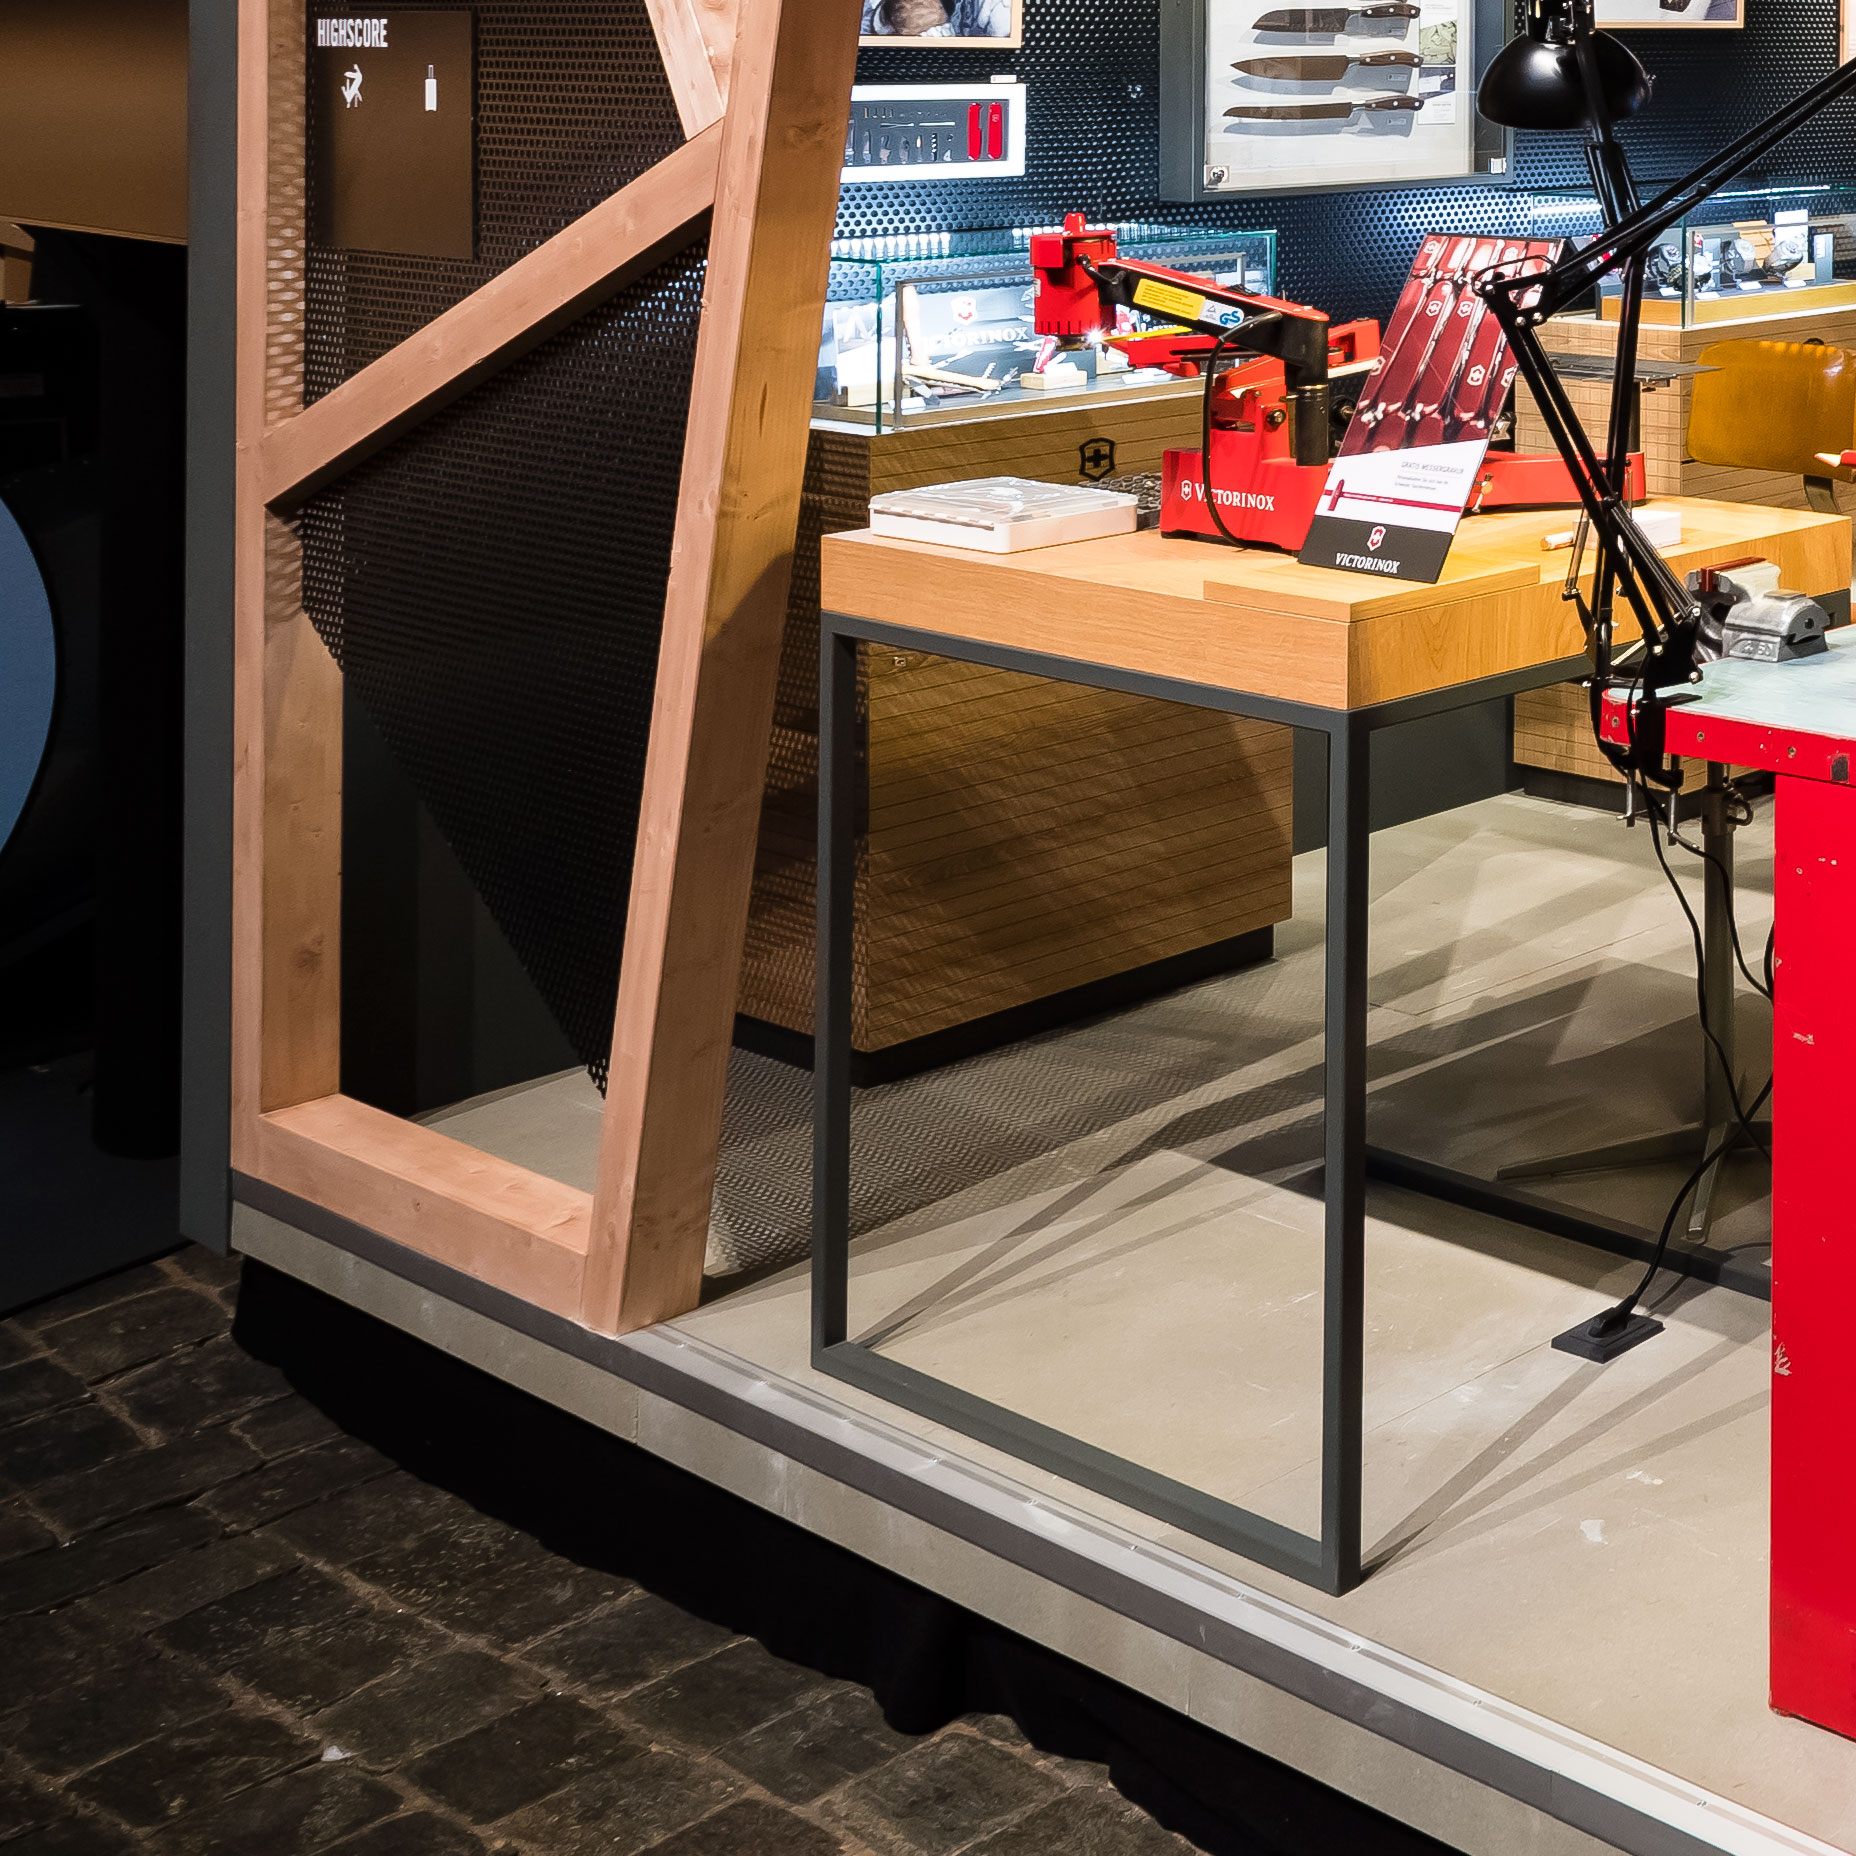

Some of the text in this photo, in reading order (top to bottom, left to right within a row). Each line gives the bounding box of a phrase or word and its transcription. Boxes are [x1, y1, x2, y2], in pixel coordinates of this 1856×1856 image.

[317, 18, 389, 48] HIGHSCORE
[1194, 482, 1275, 512] VTORINOX
[1335, 552, 1401, 574] VICTORINOX
